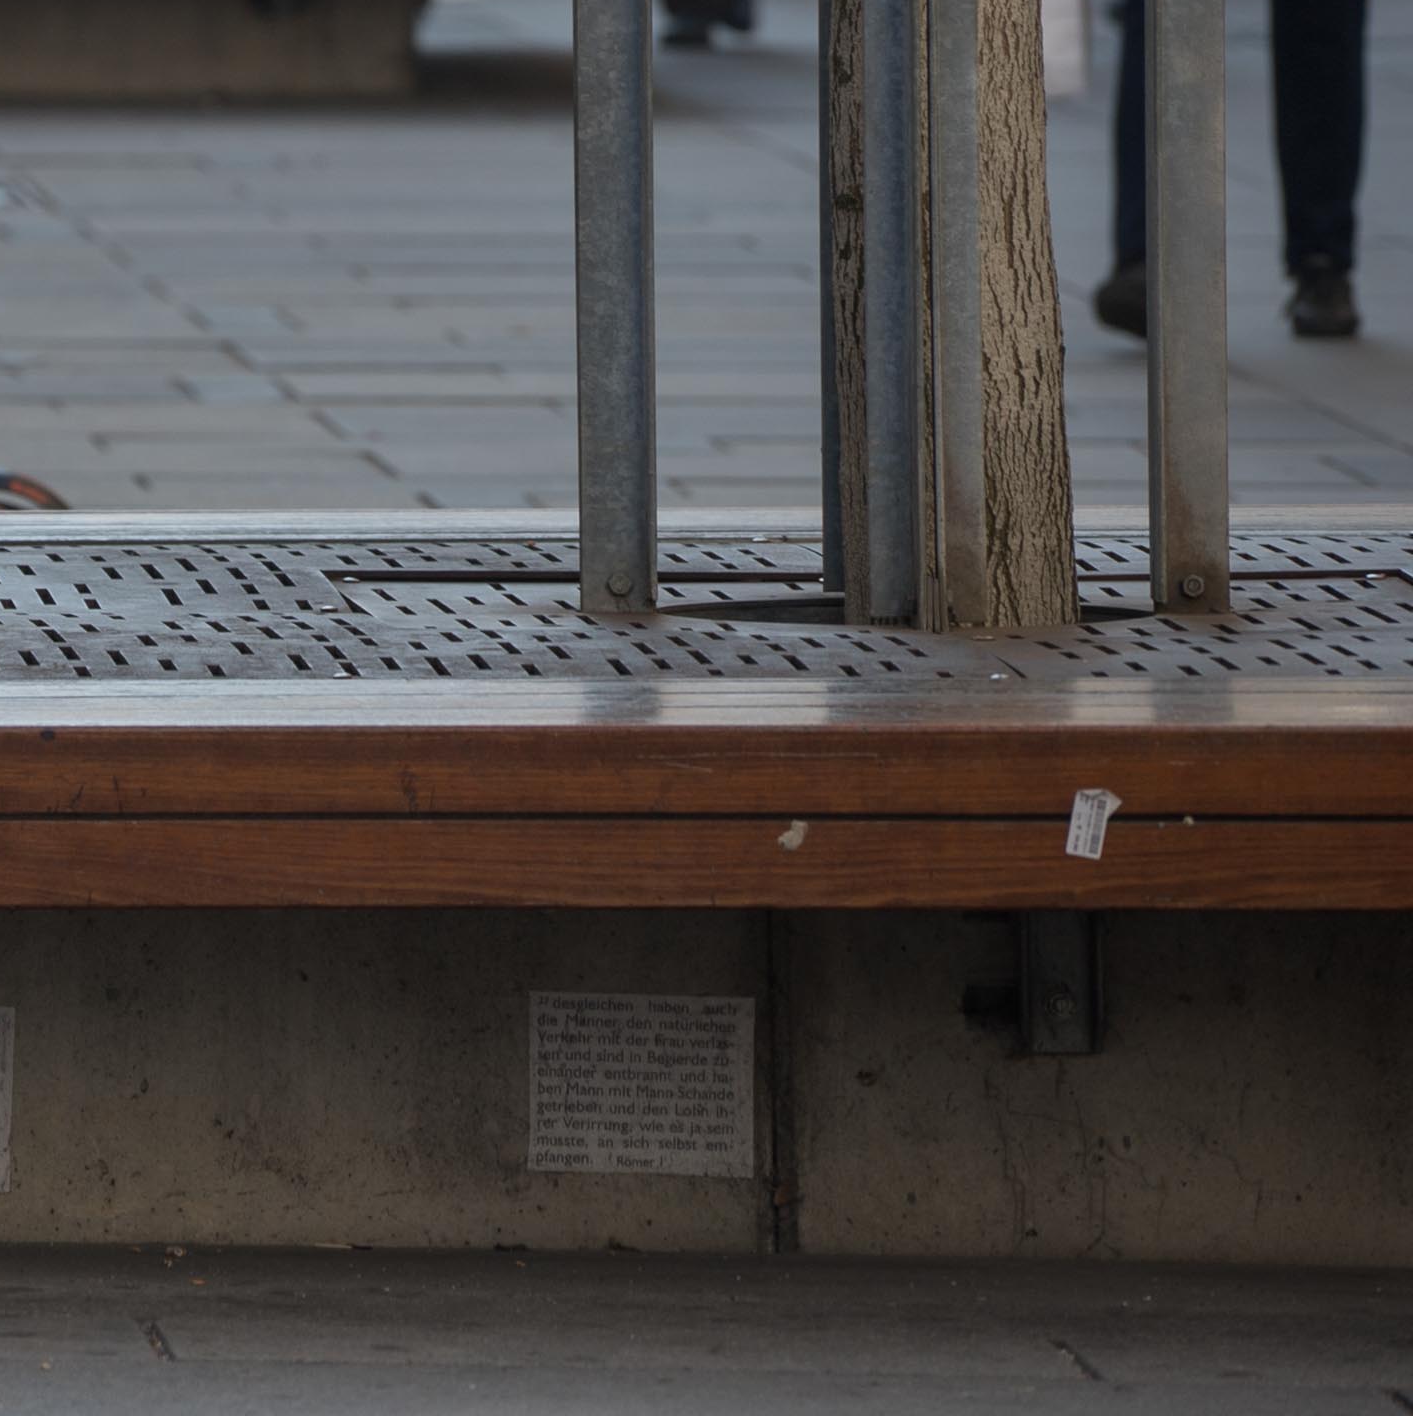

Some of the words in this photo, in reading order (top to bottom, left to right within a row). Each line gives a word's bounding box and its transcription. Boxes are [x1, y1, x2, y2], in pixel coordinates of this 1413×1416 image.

[553, 998, 633, 1015] desgleichen
[648, 1000, 689, 1015] haben
[537, 1014, 558, 1026] die
[626, 1016, 652, 1029] den
[537, 1031, 592, 1045] Verkehr
[598, 1032, 621, 1045] mit
[626, 1033, 648, 1046] der
[655, 1034, 685, 1047] Frau
[537, 1051, 560, 1061] sen
[565, 1049, 591, 1061] und
[597, 1050, 624, 1063] sind
[630, 1051, 641, 1063] in
[648, 1051, 707, 1067] Begierde
[536, 1066, 597, 1079] einander
[605, 1068, 673, 1081] entbrannt
[680, 1070, 706, 1082] und
[537, 1083, 561, 1095] ben
[567, 1083, 603, 1096] Mann
[609, 1085, 630, 1097] mit
[637, 1086, 673, 1098] Mann
[678, 1087, 734, 1100] Schande
[537, 1100, 602, 1114] getrieben
[610, 1102, 634, 1114] und
[643, 1102, 667, 1115] den
[676, 1103, 708, 1116] Lohn
[537, 1119, 556, 1129] rer
[640, 1120, 663, 1132] wie
[670, 1122, 684, 1133] es
[690, 1121, 701, 1137] ja
[707, 1122, 733, 1135] sein
[598, 1138, 613, 1148] an
[623, 1137, 649, 1149] sich
[659, 1138, 696, 1150] selbst
